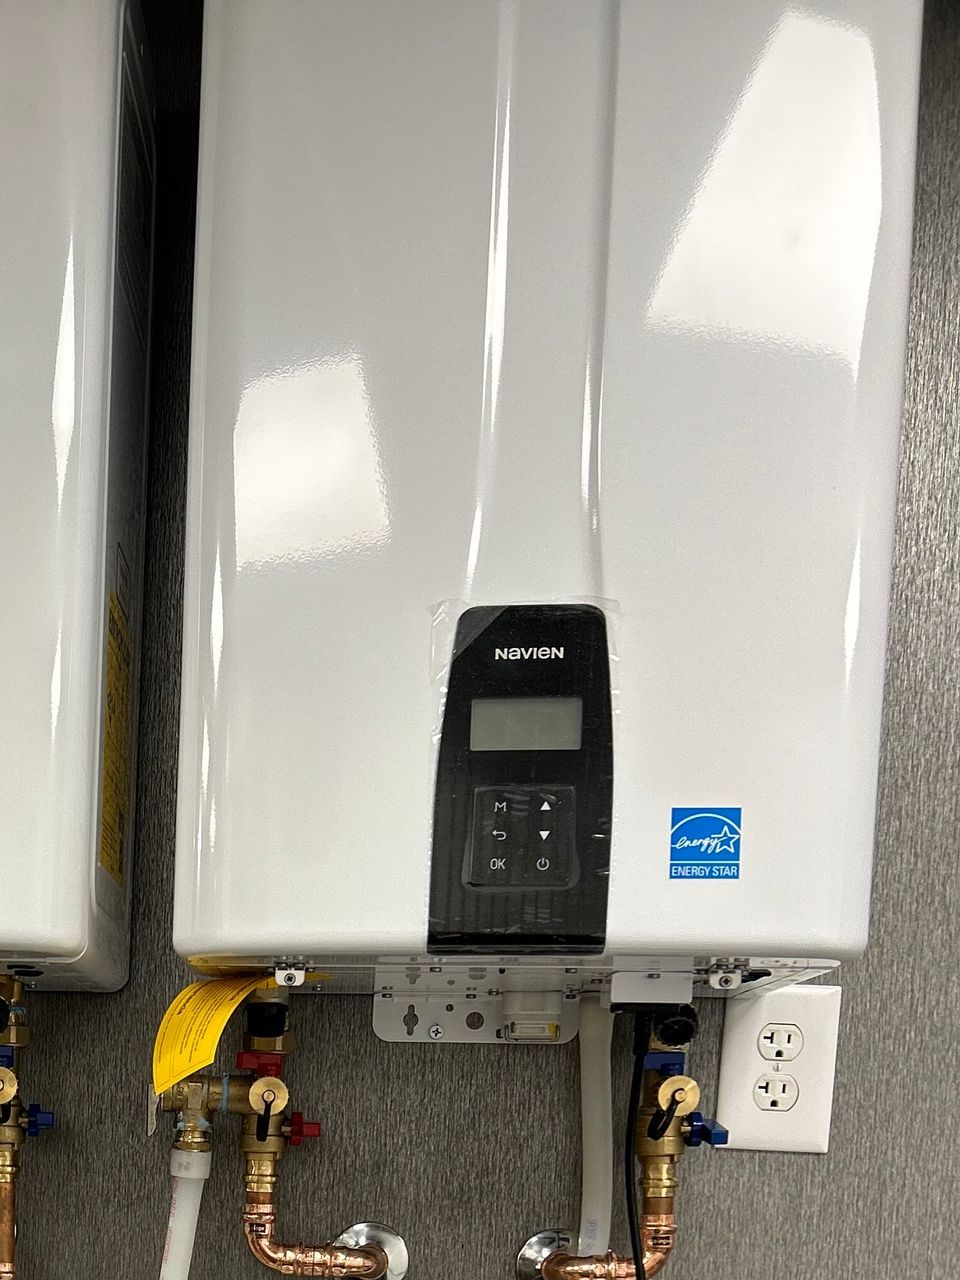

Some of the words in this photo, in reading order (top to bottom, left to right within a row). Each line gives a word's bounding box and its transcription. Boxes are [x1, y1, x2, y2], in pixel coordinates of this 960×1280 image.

[494, 801, 507, 812] M
[490, 858, 506, 870] OK
[672, 866, 710, 877] ENERGY
[712, 866, 737, 876] STAR
